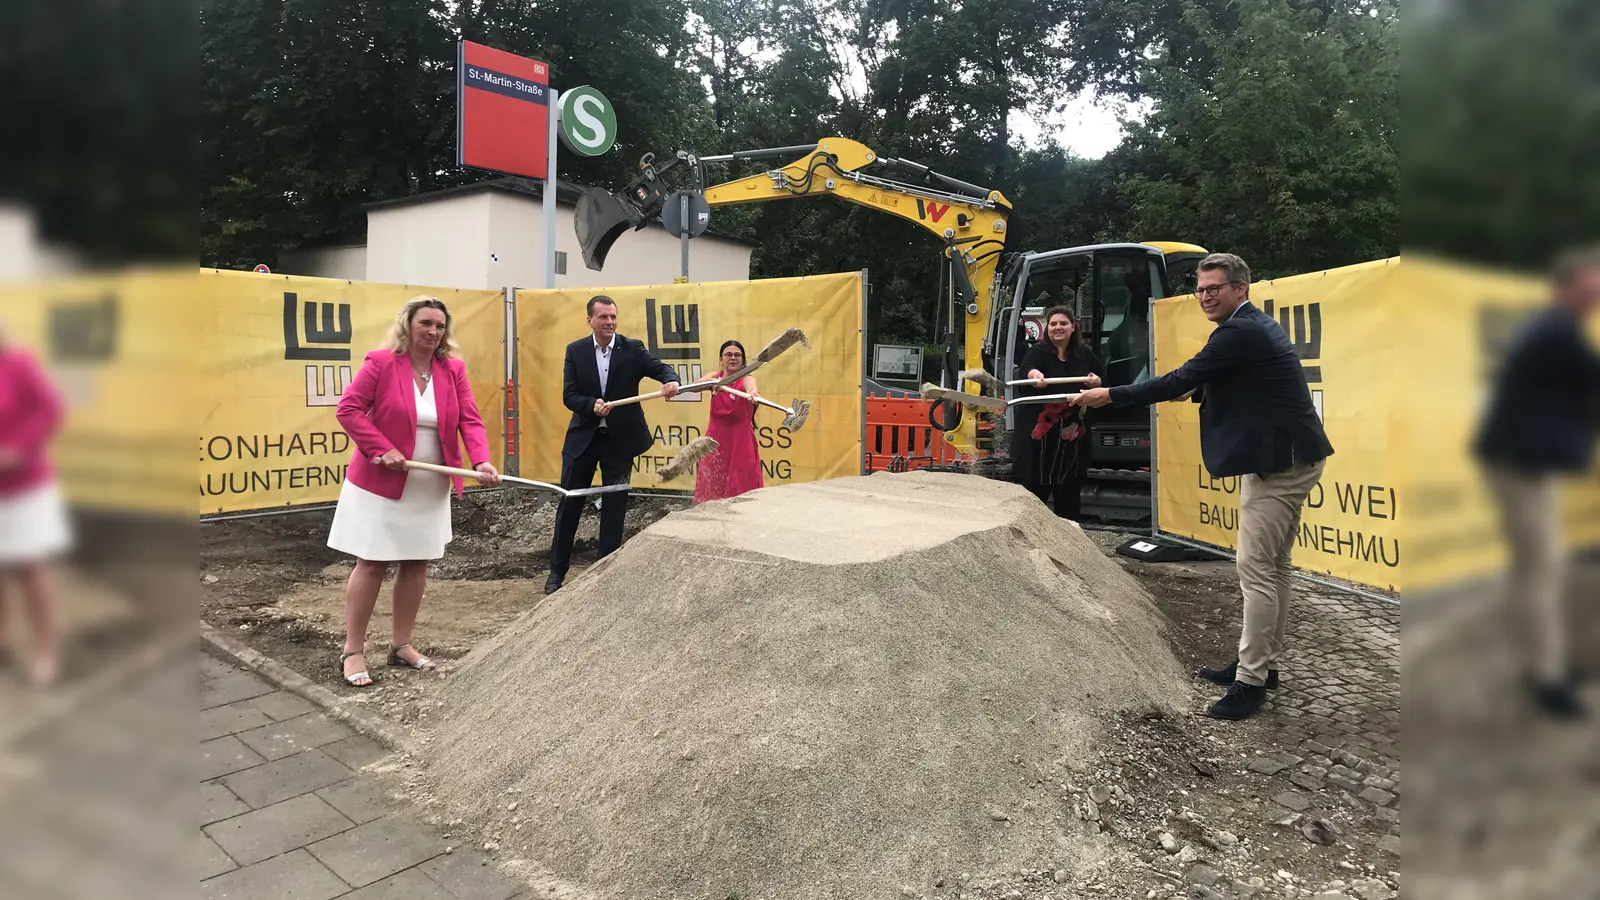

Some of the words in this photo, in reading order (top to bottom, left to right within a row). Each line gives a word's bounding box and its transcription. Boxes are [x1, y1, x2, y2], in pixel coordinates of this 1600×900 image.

[468, 68, 543, 97] St.-Martin-Straße
[572, 94, 606, 148] S
[200, 431, 350, 462] ONHARD
[200, 464, 350, 497] UUNTERN
